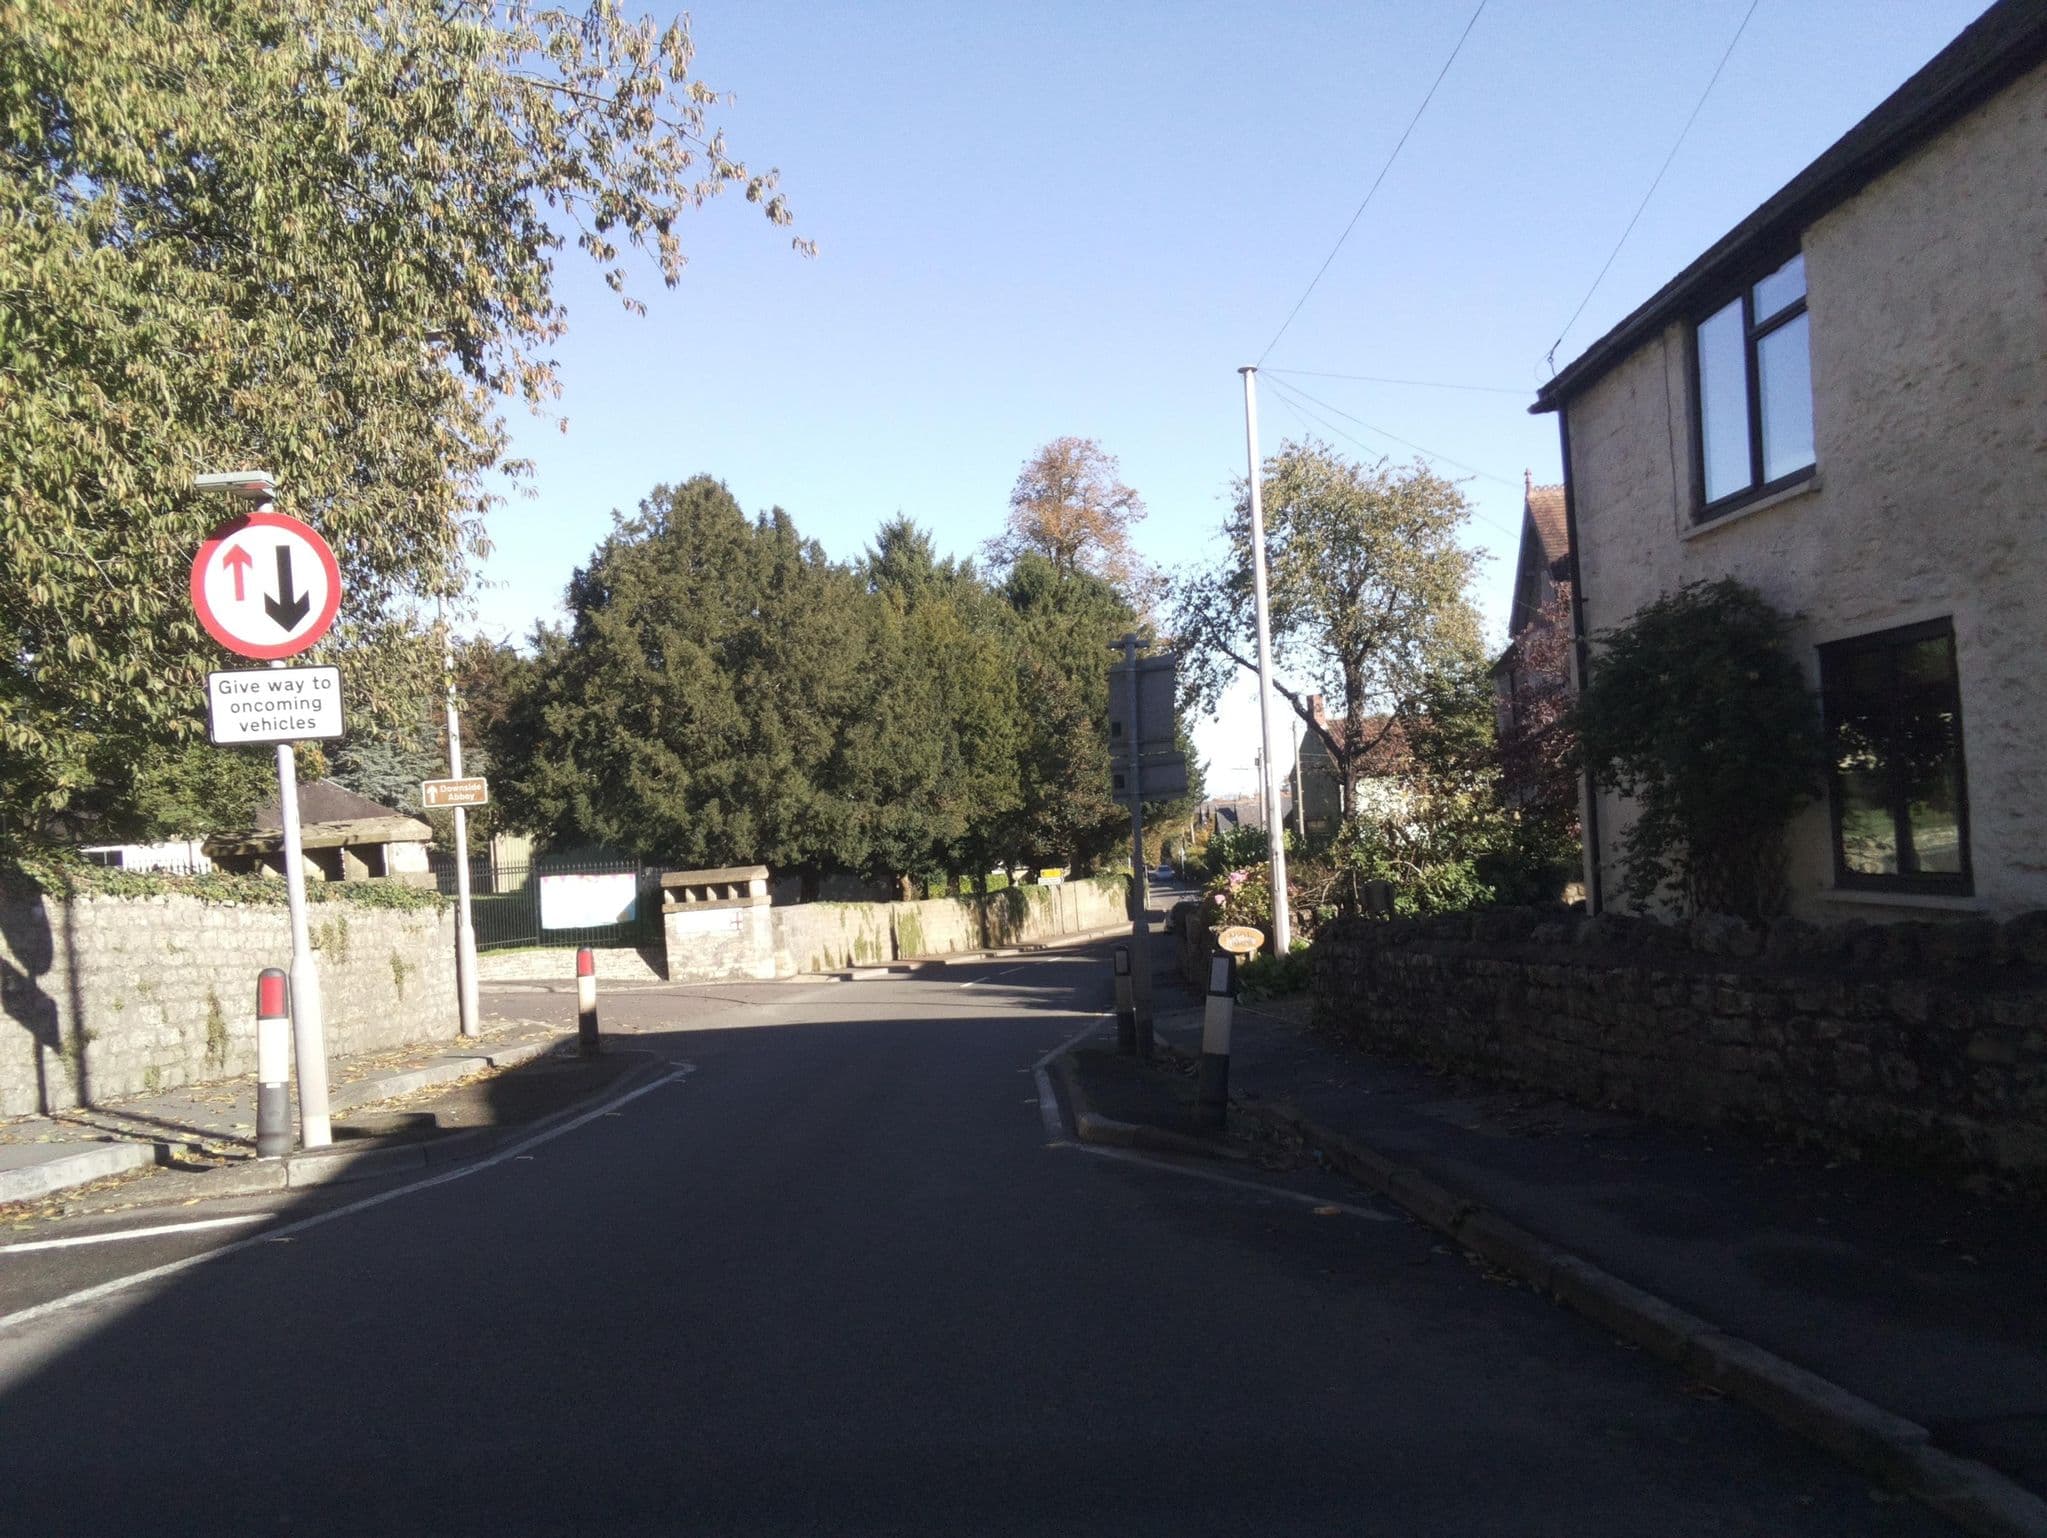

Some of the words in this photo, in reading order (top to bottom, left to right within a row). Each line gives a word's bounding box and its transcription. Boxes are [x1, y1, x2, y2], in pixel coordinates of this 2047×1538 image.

[218, 680, 260, 694] Give
[268, 680, 304, 693] way
[313, 676, 331, 690] to
[230, 697, 322, 712] oncoming
[240, 716, 316, 732] vehicles
